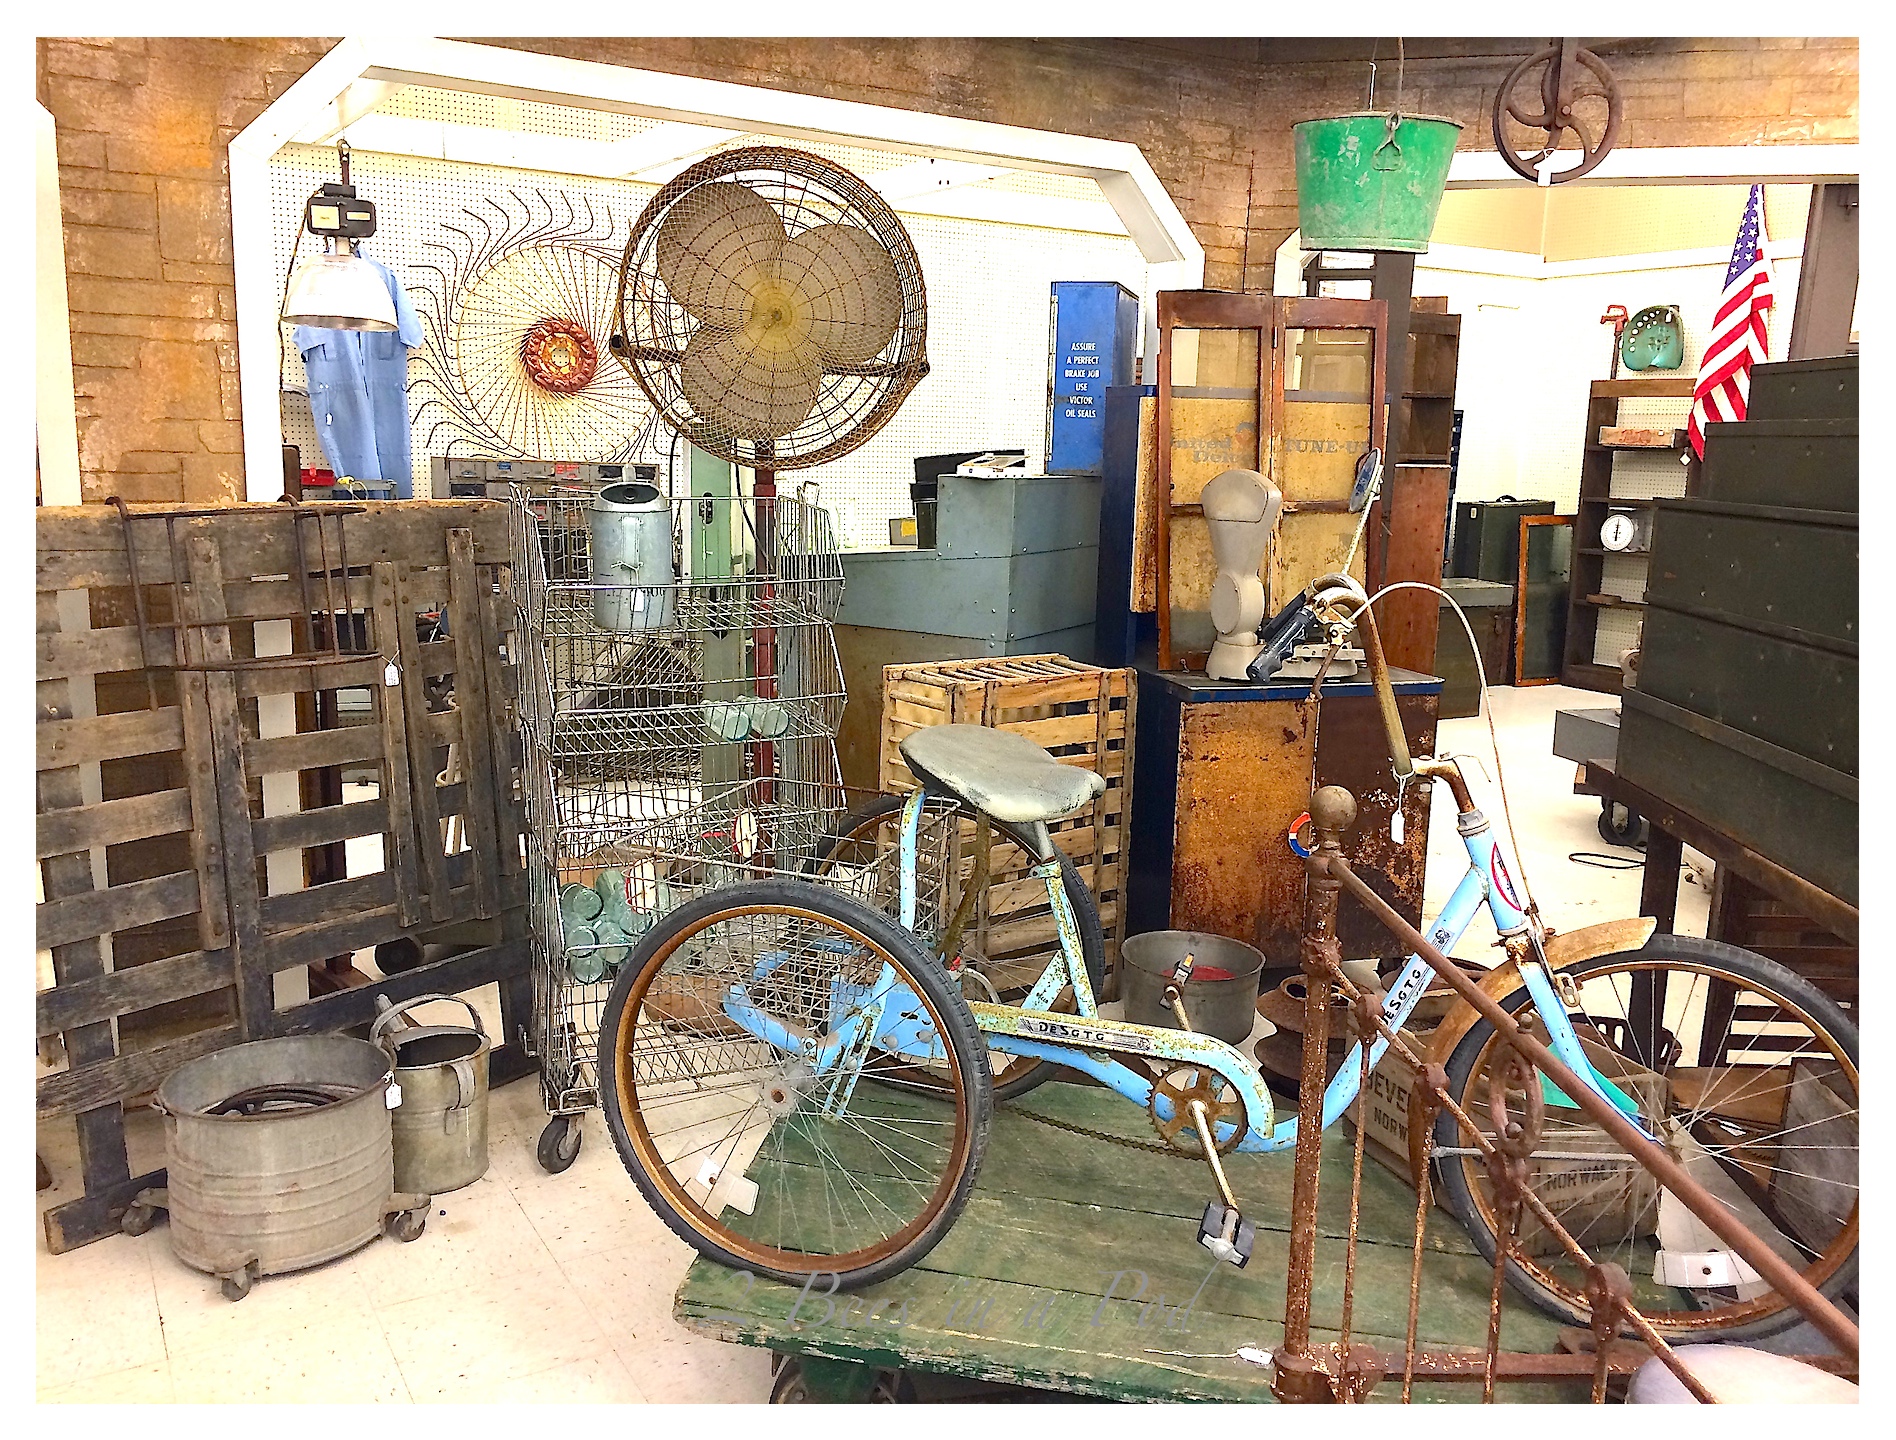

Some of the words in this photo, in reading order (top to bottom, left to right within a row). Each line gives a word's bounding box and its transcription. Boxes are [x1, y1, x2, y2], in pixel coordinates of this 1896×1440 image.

[1071, 343, 1096, 351] ASSURE
[1066, 356, 1072, 365] A
[1073, 356, 1100, 365] PERFECT
[1064, 370, 1086, 378] BRAKE
[1087, 370, 1100, 378] JOB
[1075, 383, 1088, 391] USE
[1069, 396, 1093, 404] VICTOR
[1065, 409, 1076, 418] OIL
[1077, 409, 1096, 418] SEALS
